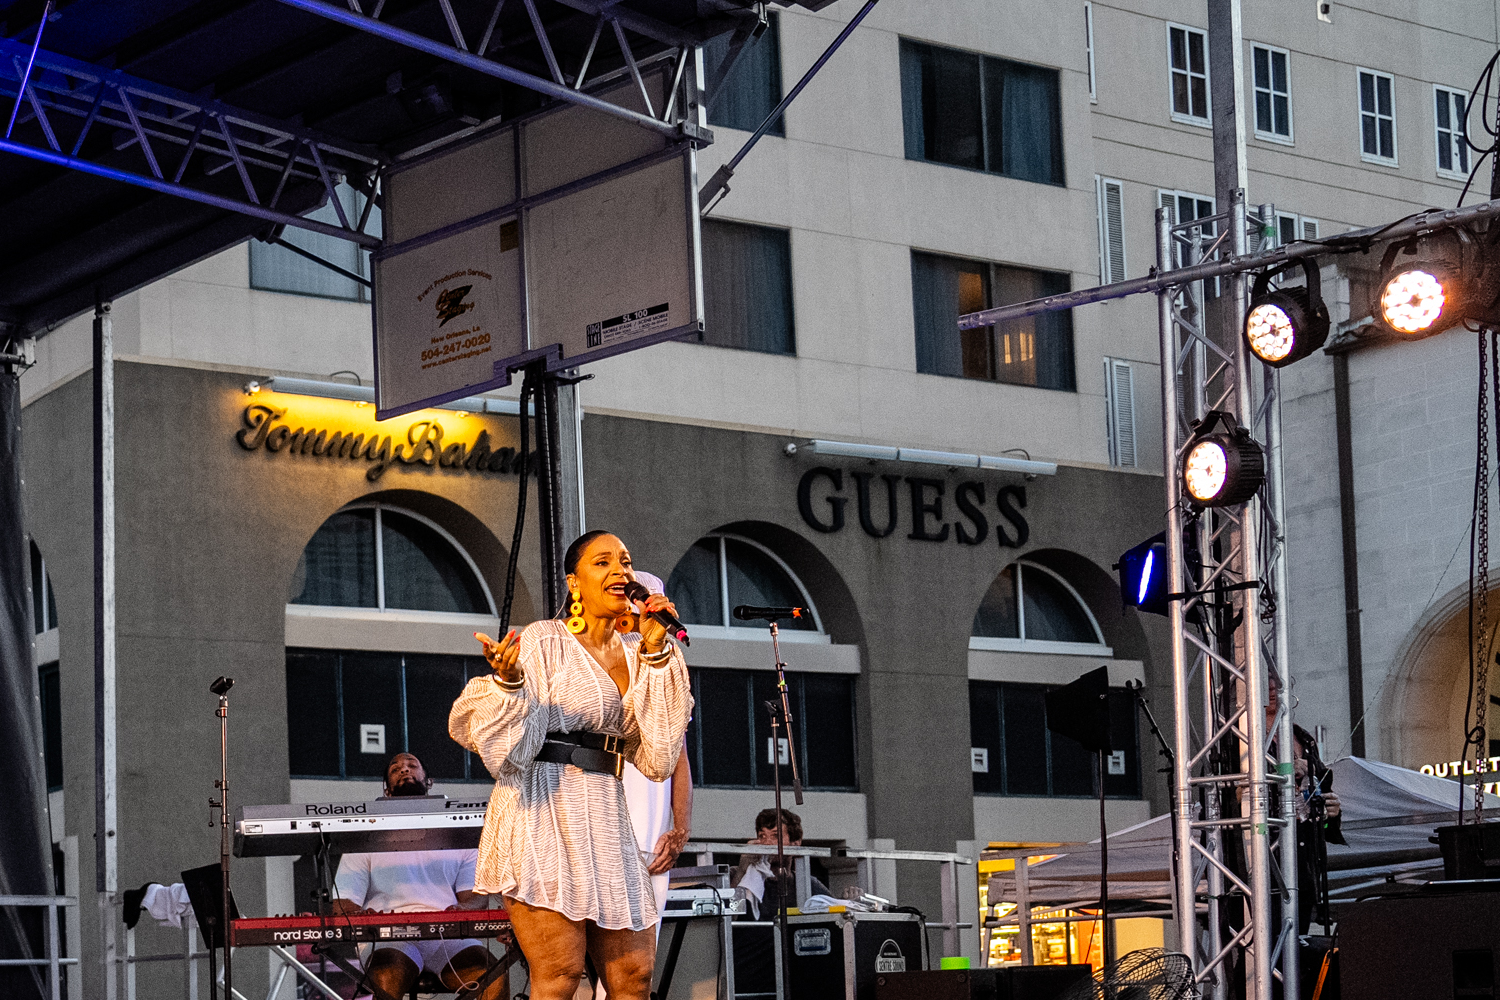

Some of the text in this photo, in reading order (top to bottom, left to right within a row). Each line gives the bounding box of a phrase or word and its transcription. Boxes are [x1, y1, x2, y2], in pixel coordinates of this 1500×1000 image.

[434, 270, 467, 287] Production
[603, 326, 618, 335] MOBILE
[619, 322, 633, 331] STAGE
[653, 312, 669, 322] MOBILE
[622, 308, 649, 323] SL 100
[421, 332, 492, 362] 504-247-0020
[236, 404, 393, 481] Tommy
[796, 465, 1030, 548] GUESS
[305, 802, 367, 816] Roland
[273, 929, 301, 941] nord
[335, 928, 343, 939] 3
